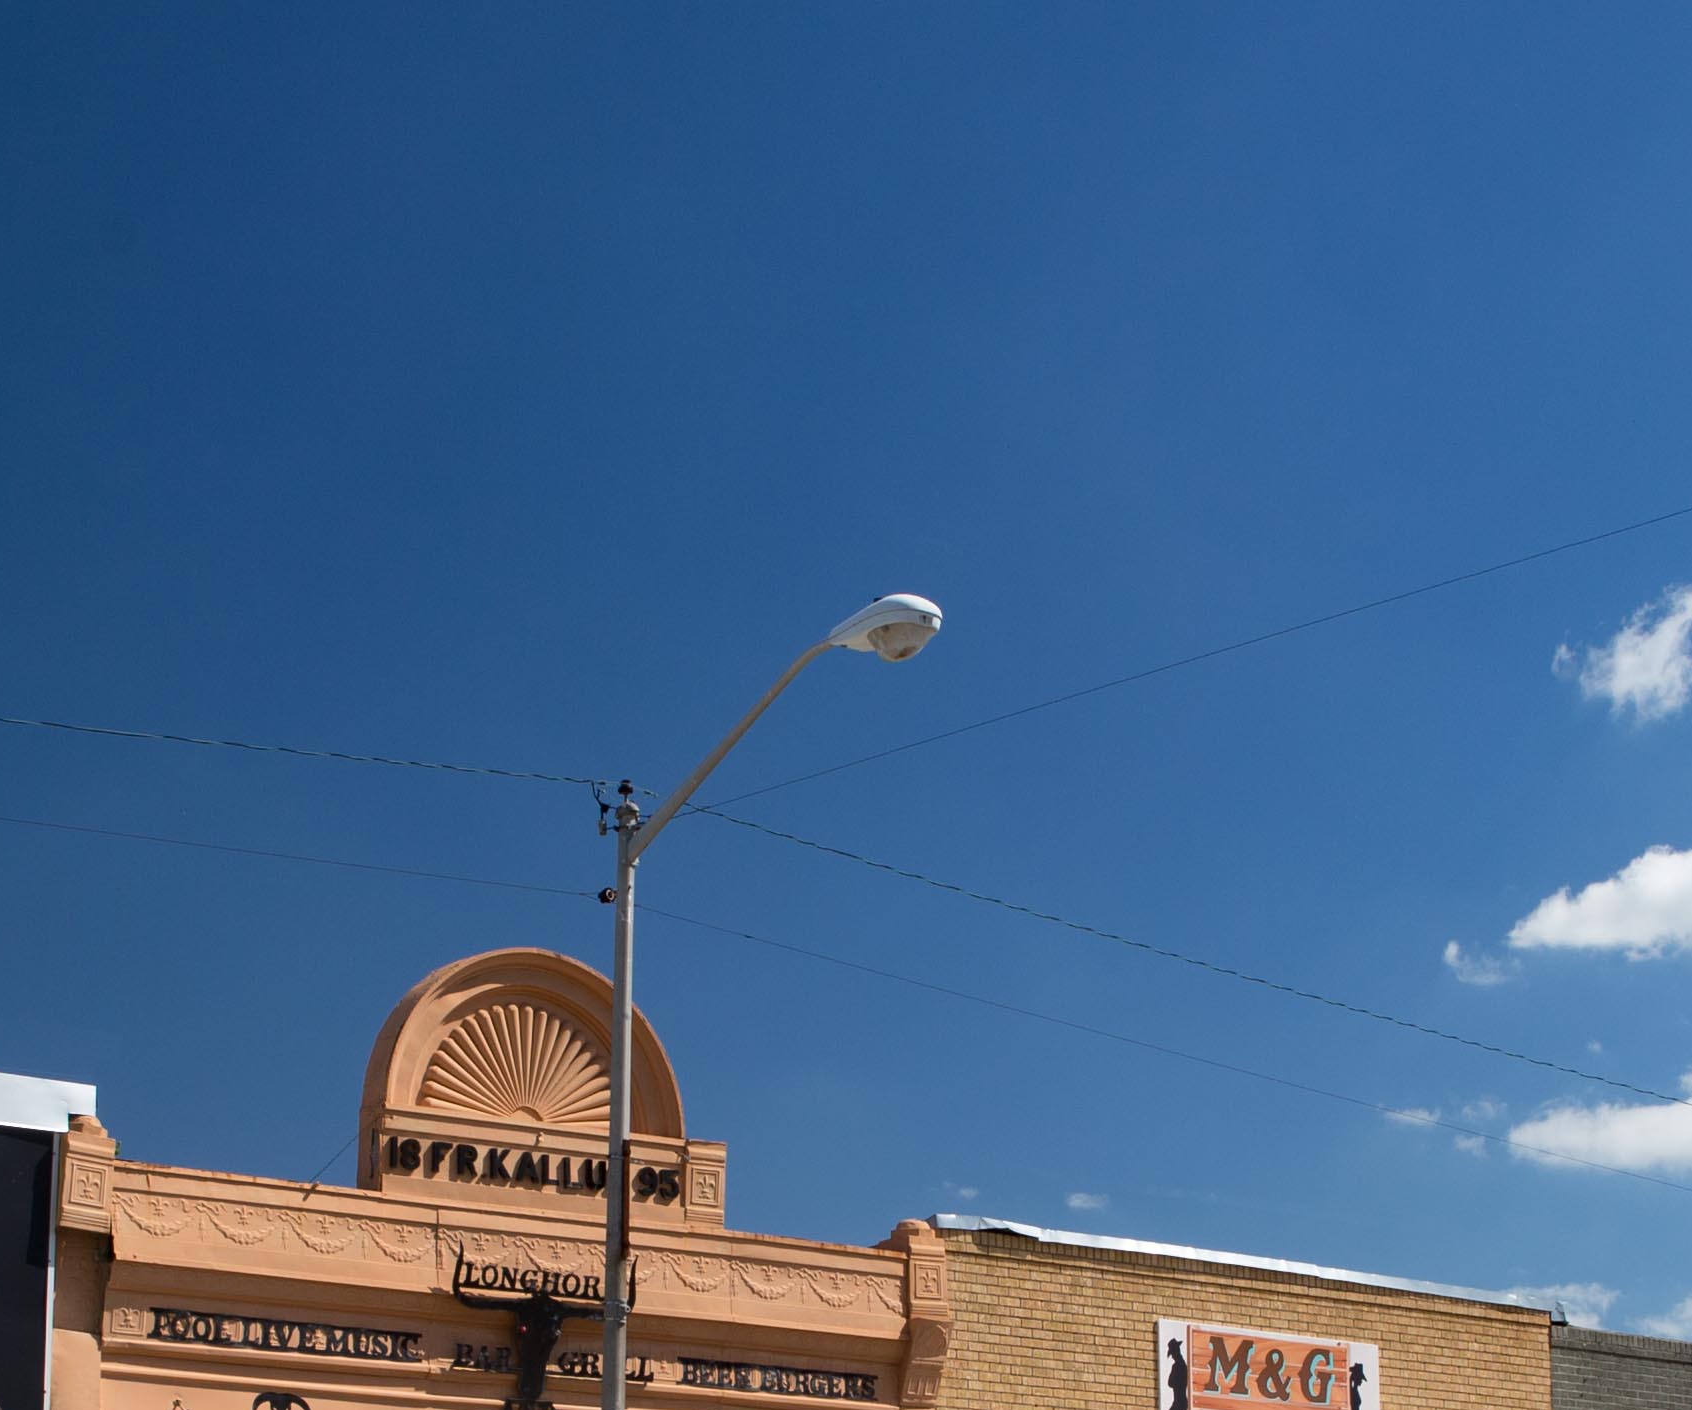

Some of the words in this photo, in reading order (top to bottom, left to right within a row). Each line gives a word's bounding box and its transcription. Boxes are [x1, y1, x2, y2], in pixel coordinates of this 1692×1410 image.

[388, 1136, 422, 1171] 18
[488, 1147, 608, 1191] KALLU
[636, 1166, 680, 1198] 95
[460, 1261, 606, 1299] LONGHOR
[760, 1366, 879, 1400] BURGERS
